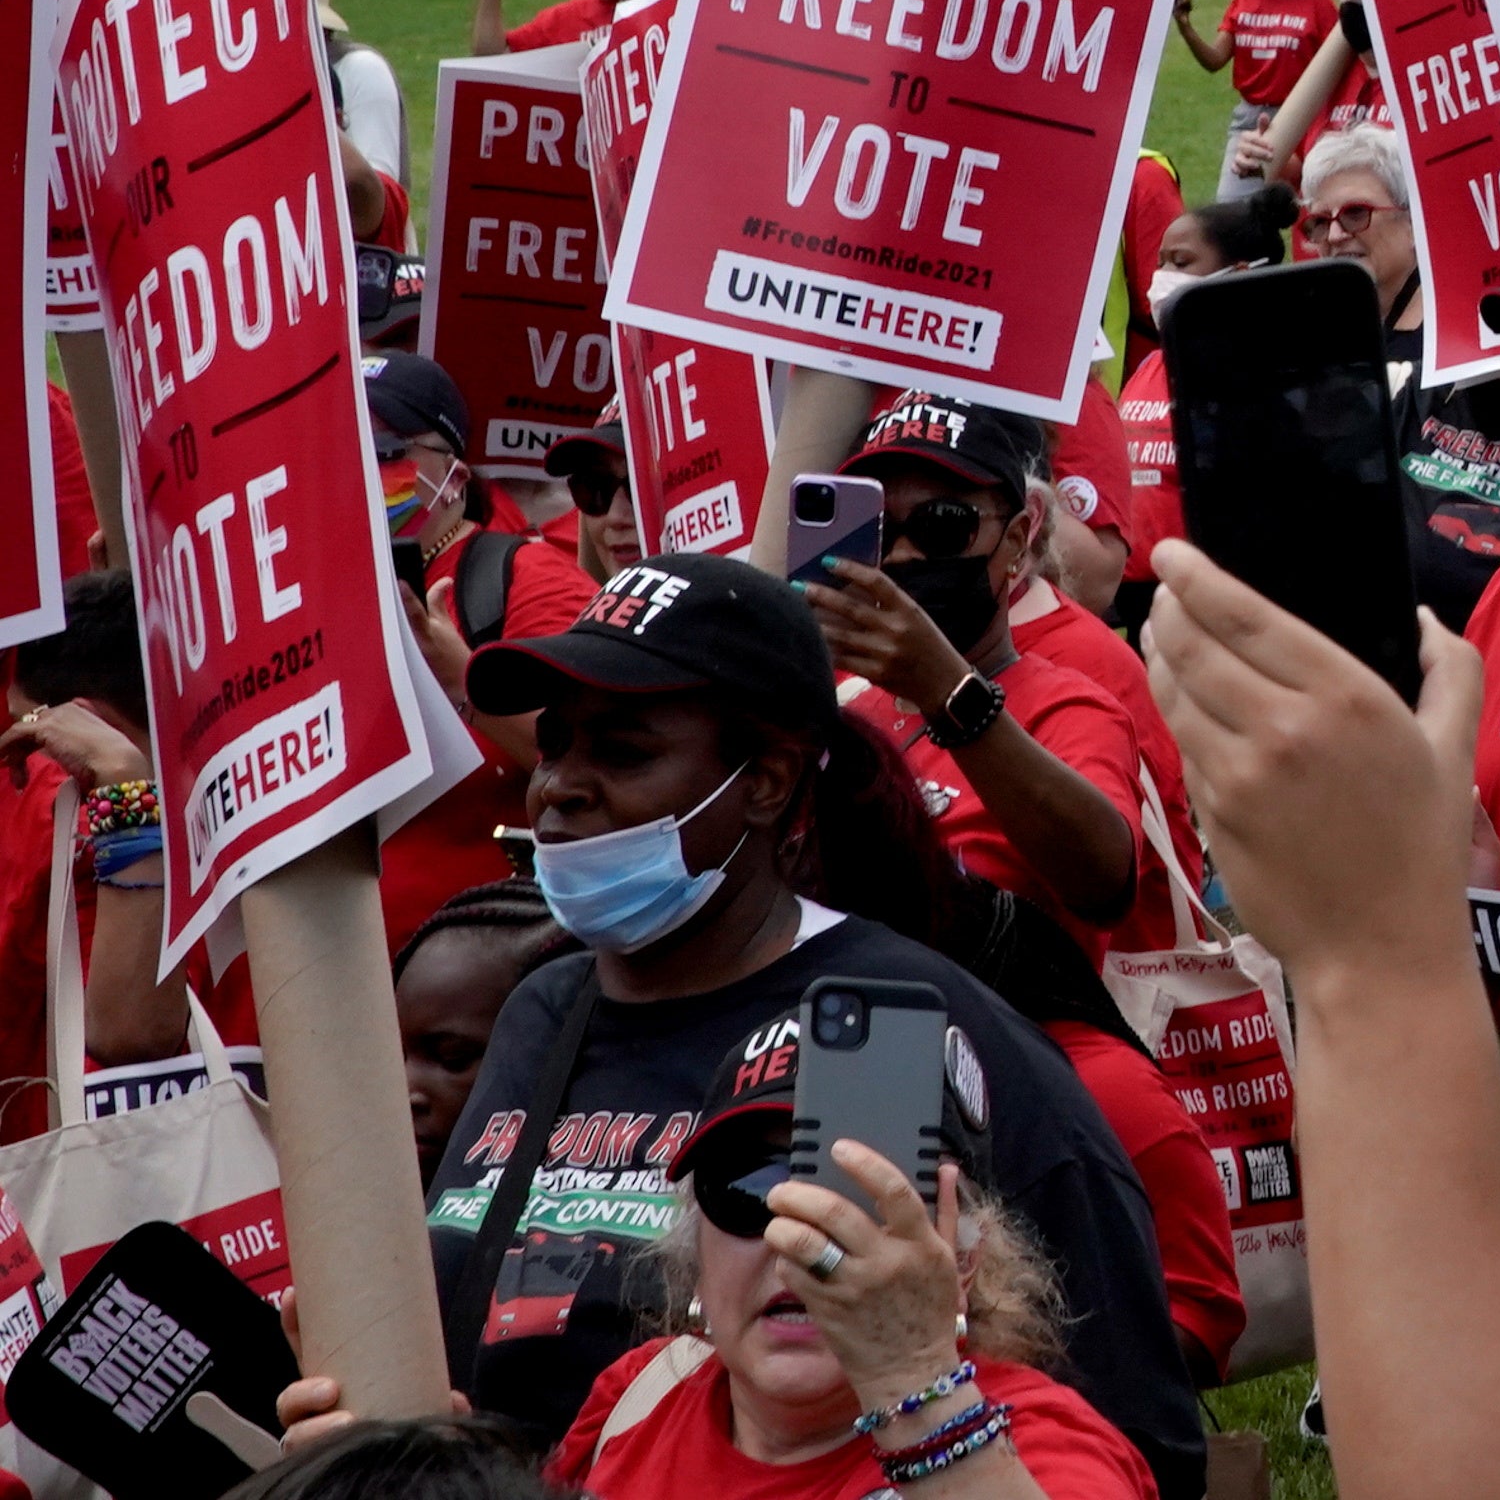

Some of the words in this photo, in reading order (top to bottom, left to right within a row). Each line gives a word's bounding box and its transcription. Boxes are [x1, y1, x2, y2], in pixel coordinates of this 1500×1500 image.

[888, 70, 930, 115] TO
[785, 106, 1000, 247] VOTE
[741, 216, 994, 291] #FreedomRide2021
[726, 267, 986, 354] UNITEHERE!
[169, 422, 199, 490] TO
[1408, 458, 1440, 479] THE
[154, 464, 301, 699] VOTE
[1213, 1071, 1289, 1112] RIGHTS
[219, 1217, 281, 1267] RIDE
[437, 1196, 489, 1220] THE
[81, 1303, 180, 1406] VOTERS
[112, 1328, 212, 1434] MATTER
